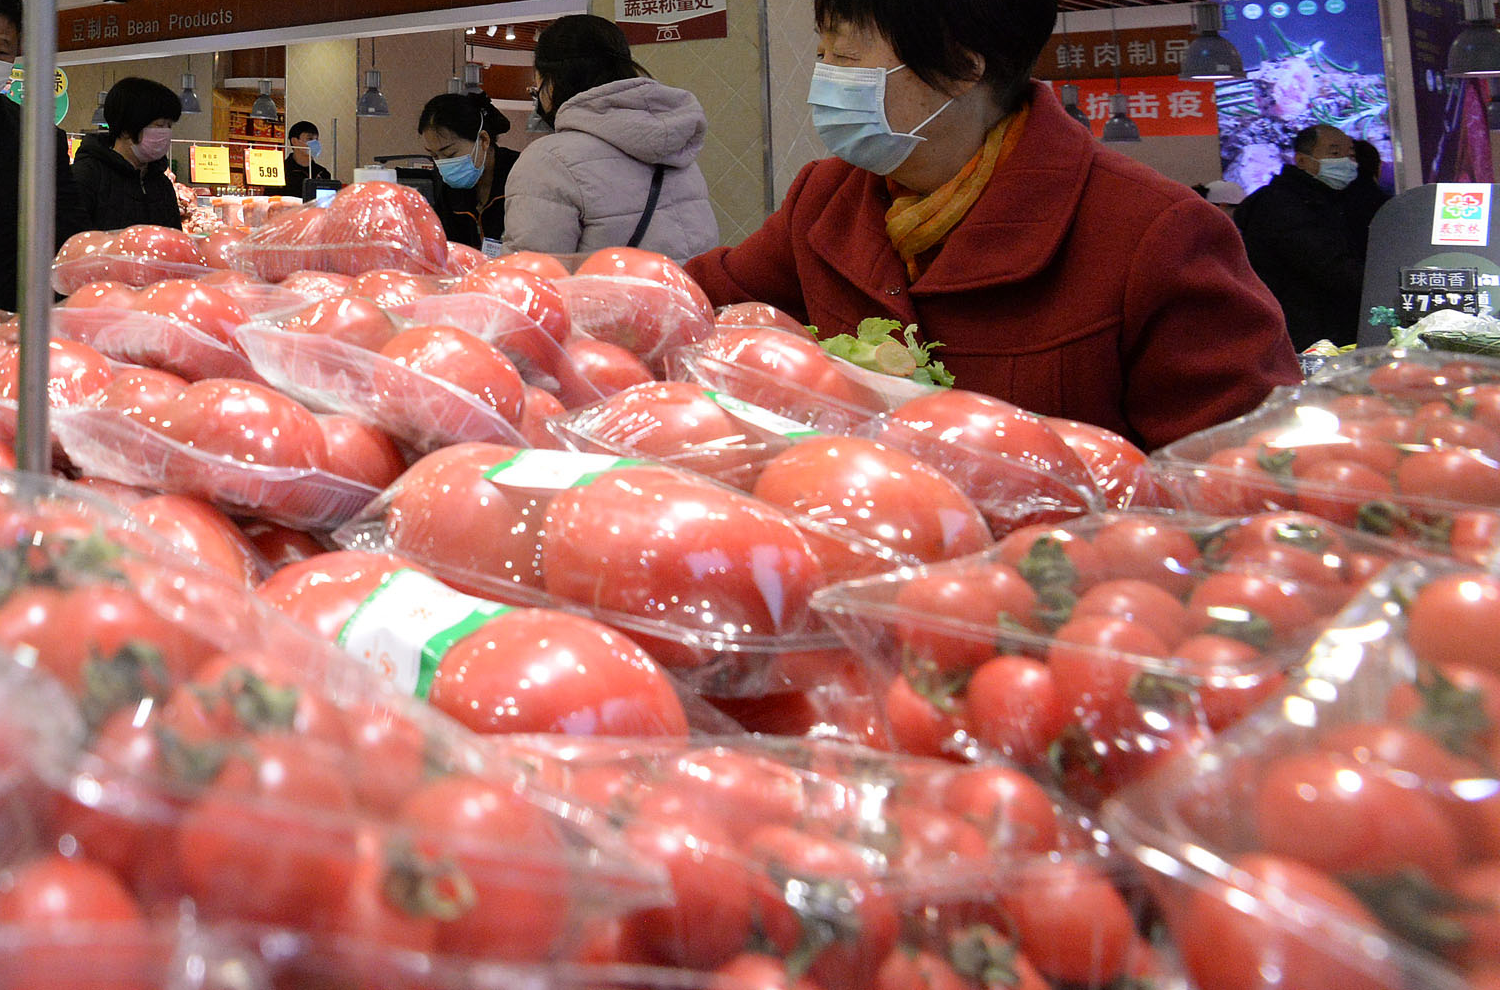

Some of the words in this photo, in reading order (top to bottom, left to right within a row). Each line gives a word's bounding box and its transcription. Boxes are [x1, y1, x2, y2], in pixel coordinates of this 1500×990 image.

[71, 15, 119, 42] 豆制品
[127, 19, 160, 36] Bean
[169, 8, 233, 31] Products
[1056, 39, 1190, 69] 鲜肉制品
[1086, 89, 1216, 121] 抗击疫
[258, 166, 279, 178] 5.99
[1409, 272, 1465, 287] 球茴香
